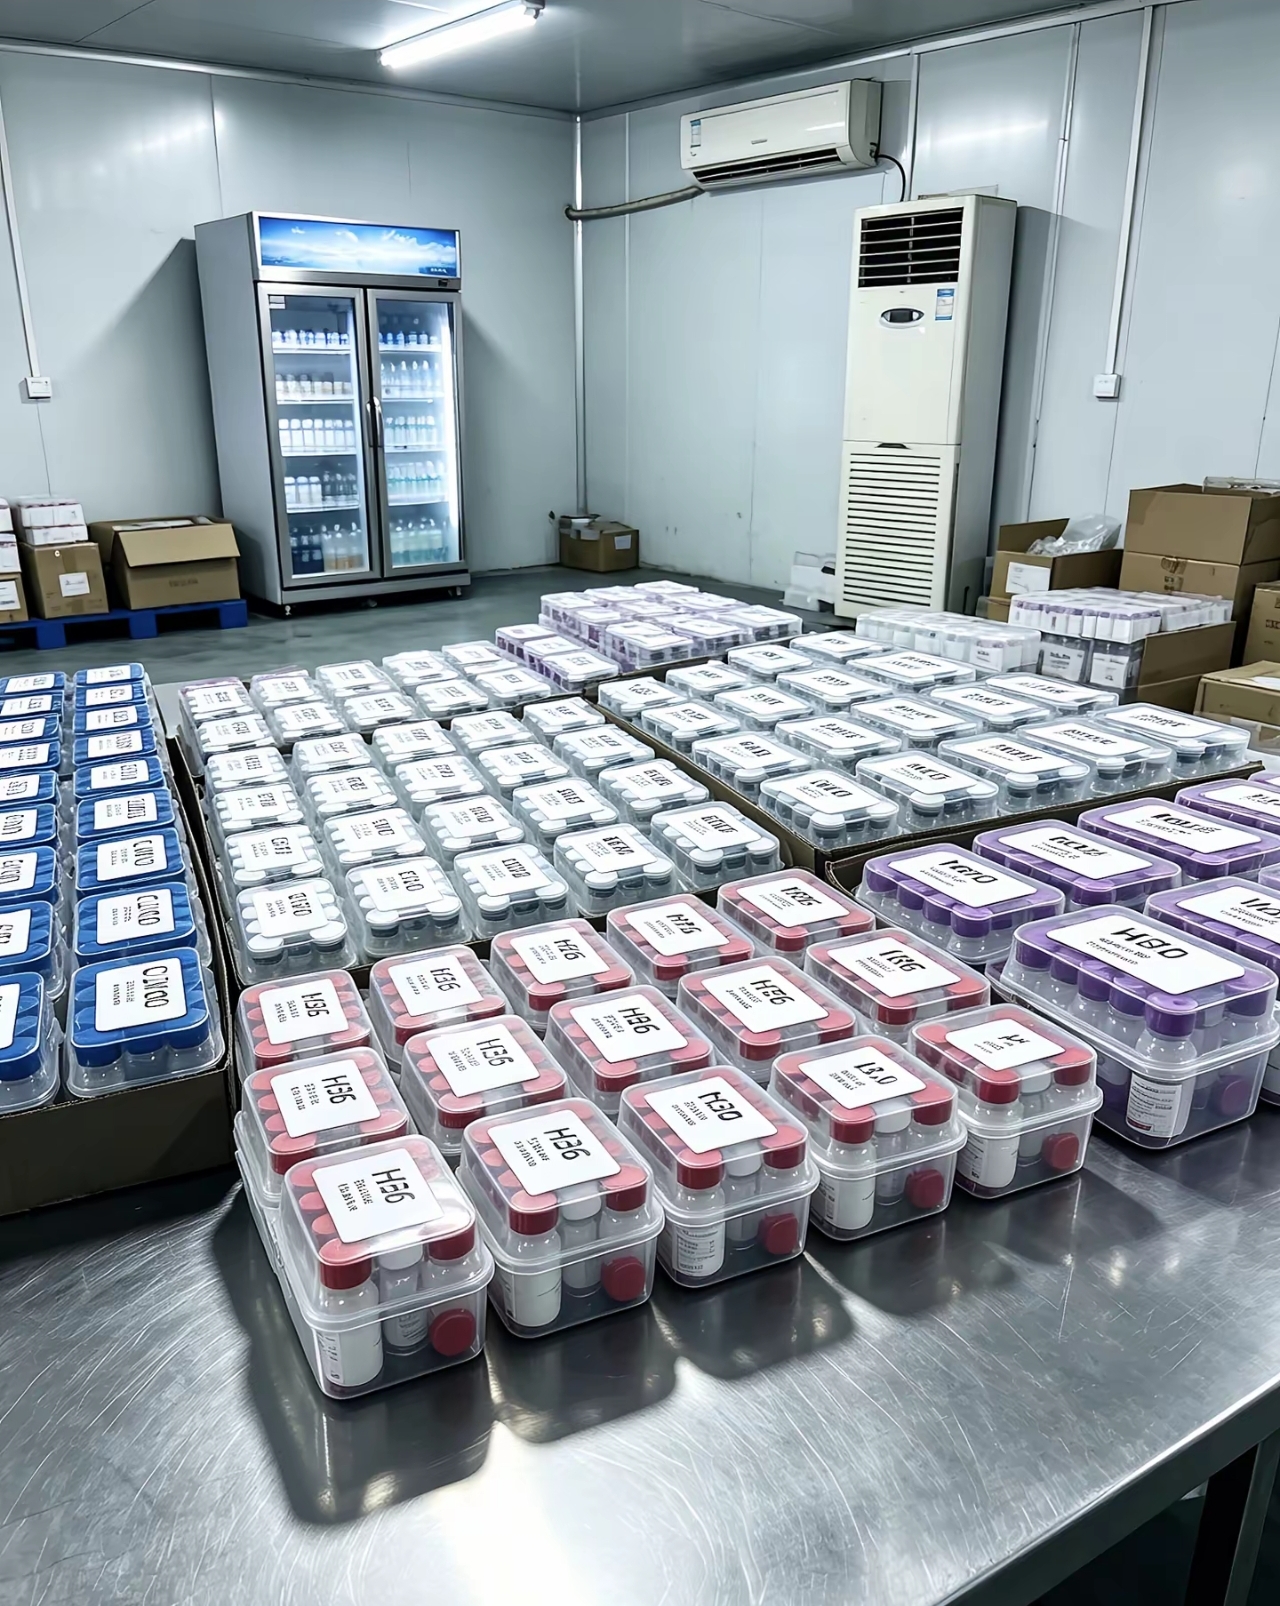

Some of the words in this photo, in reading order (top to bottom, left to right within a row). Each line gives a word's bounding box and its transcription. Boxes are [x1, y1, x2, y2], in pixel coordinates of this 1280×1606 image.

[477, 1039, 514, 1066] H36
[322, 1075, 356, 1103] H36
[544, 1128, 590, 1160] H36
[372, 1169, 415, 1203] H36
